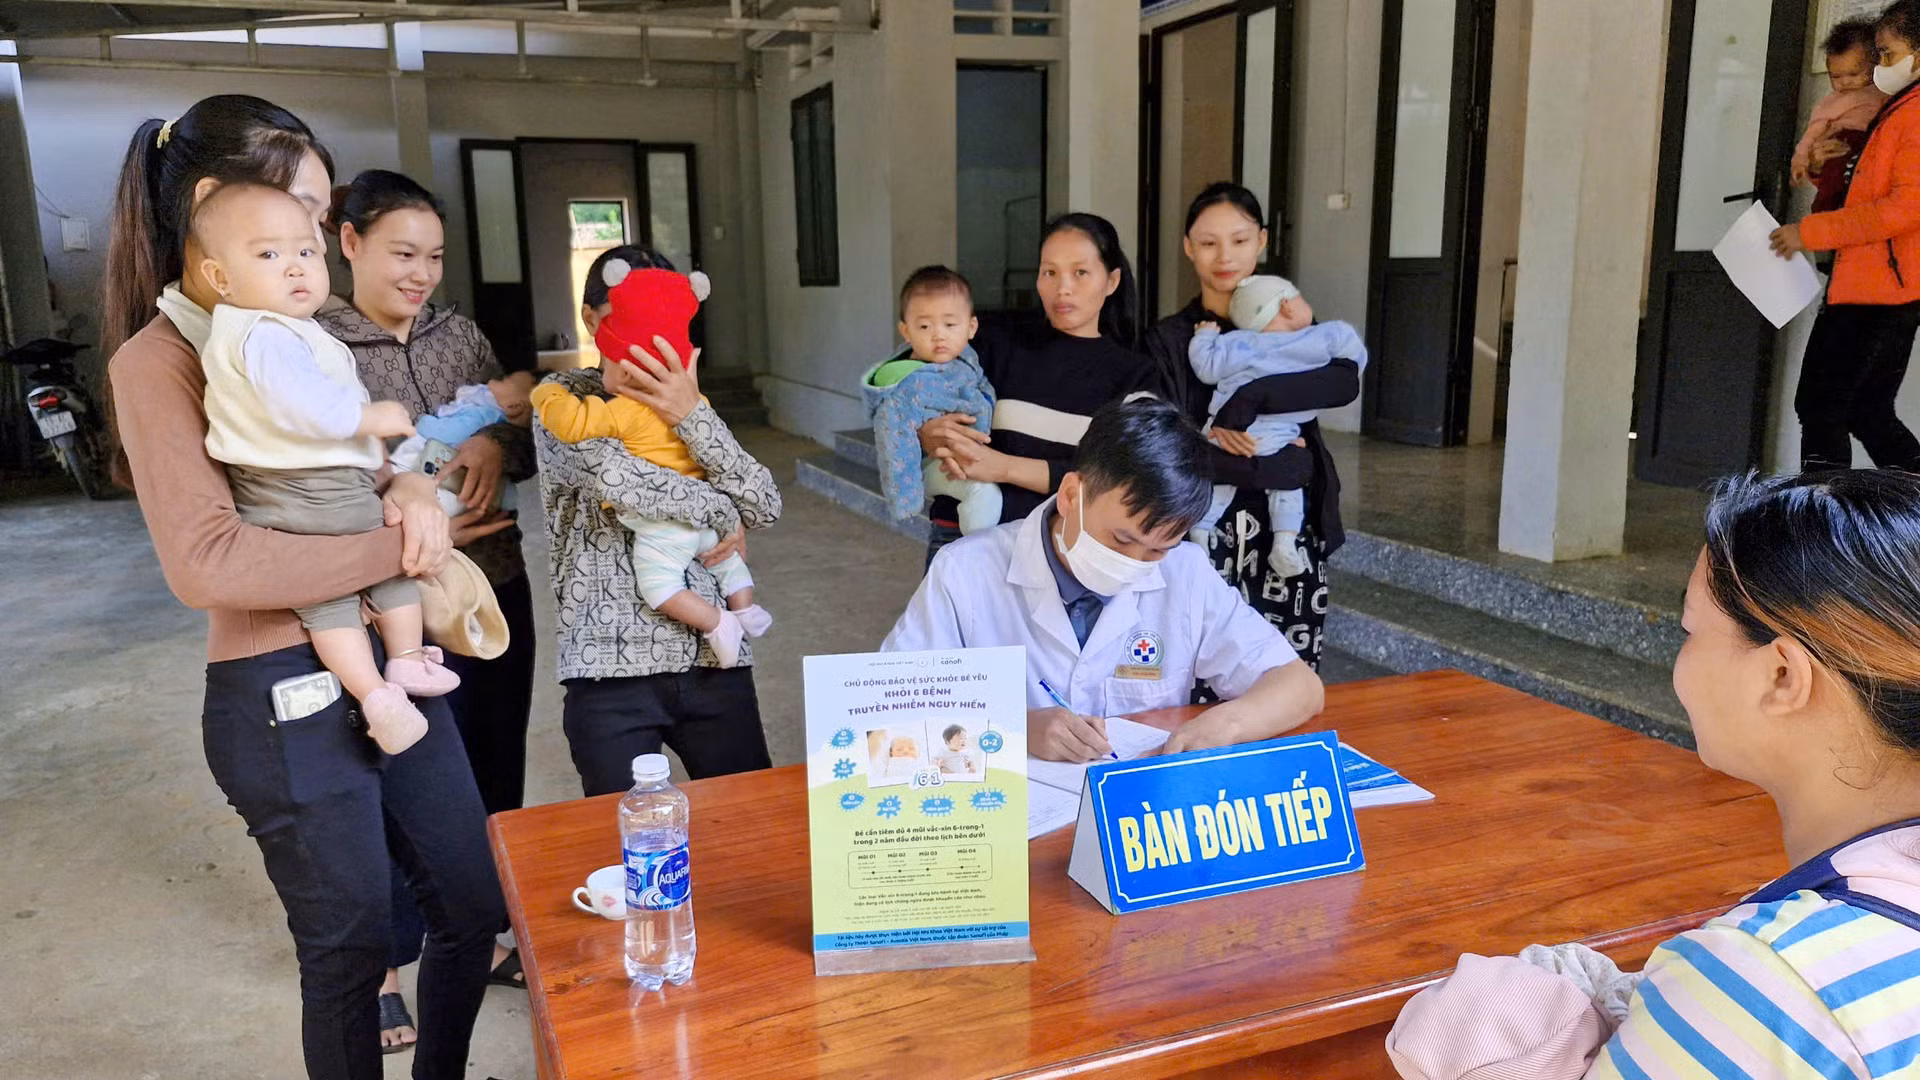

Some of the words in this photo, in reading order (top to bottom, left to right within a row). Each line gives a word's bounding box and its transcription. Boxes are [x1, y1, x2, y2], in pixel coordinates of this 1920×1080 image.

[844, 678, 861, 687] CHỦ
[863, 679, 887, 687] ĐỘNG
[888, 676, 905, 686] BẢO
[907, 676, 917, 685] VỆ
[919, 674, 935, 684] SỨC
[936, 673, 958, 683] KHỎE
[960, 673, 971, 682] BÉ
[972, 673, 988, 681] YÊU
[922, 686, 951, 697] BỆNH
[848, 701, 889, 716] TRUYỀN
[928, 700, 957, 709] NGUY
[959, 699, 987, 709] HIỂM
[982, 738, 998, 747] 0-2
[952, 823, 984, 831] 6-trong-1
[1118, 801, 1191, 873] BÀN
[1192, 789, 1265, 860] ĐÓN
[1264, 770, 1333, 847] TIẾP
[968, 831, 986, 839] dưới
